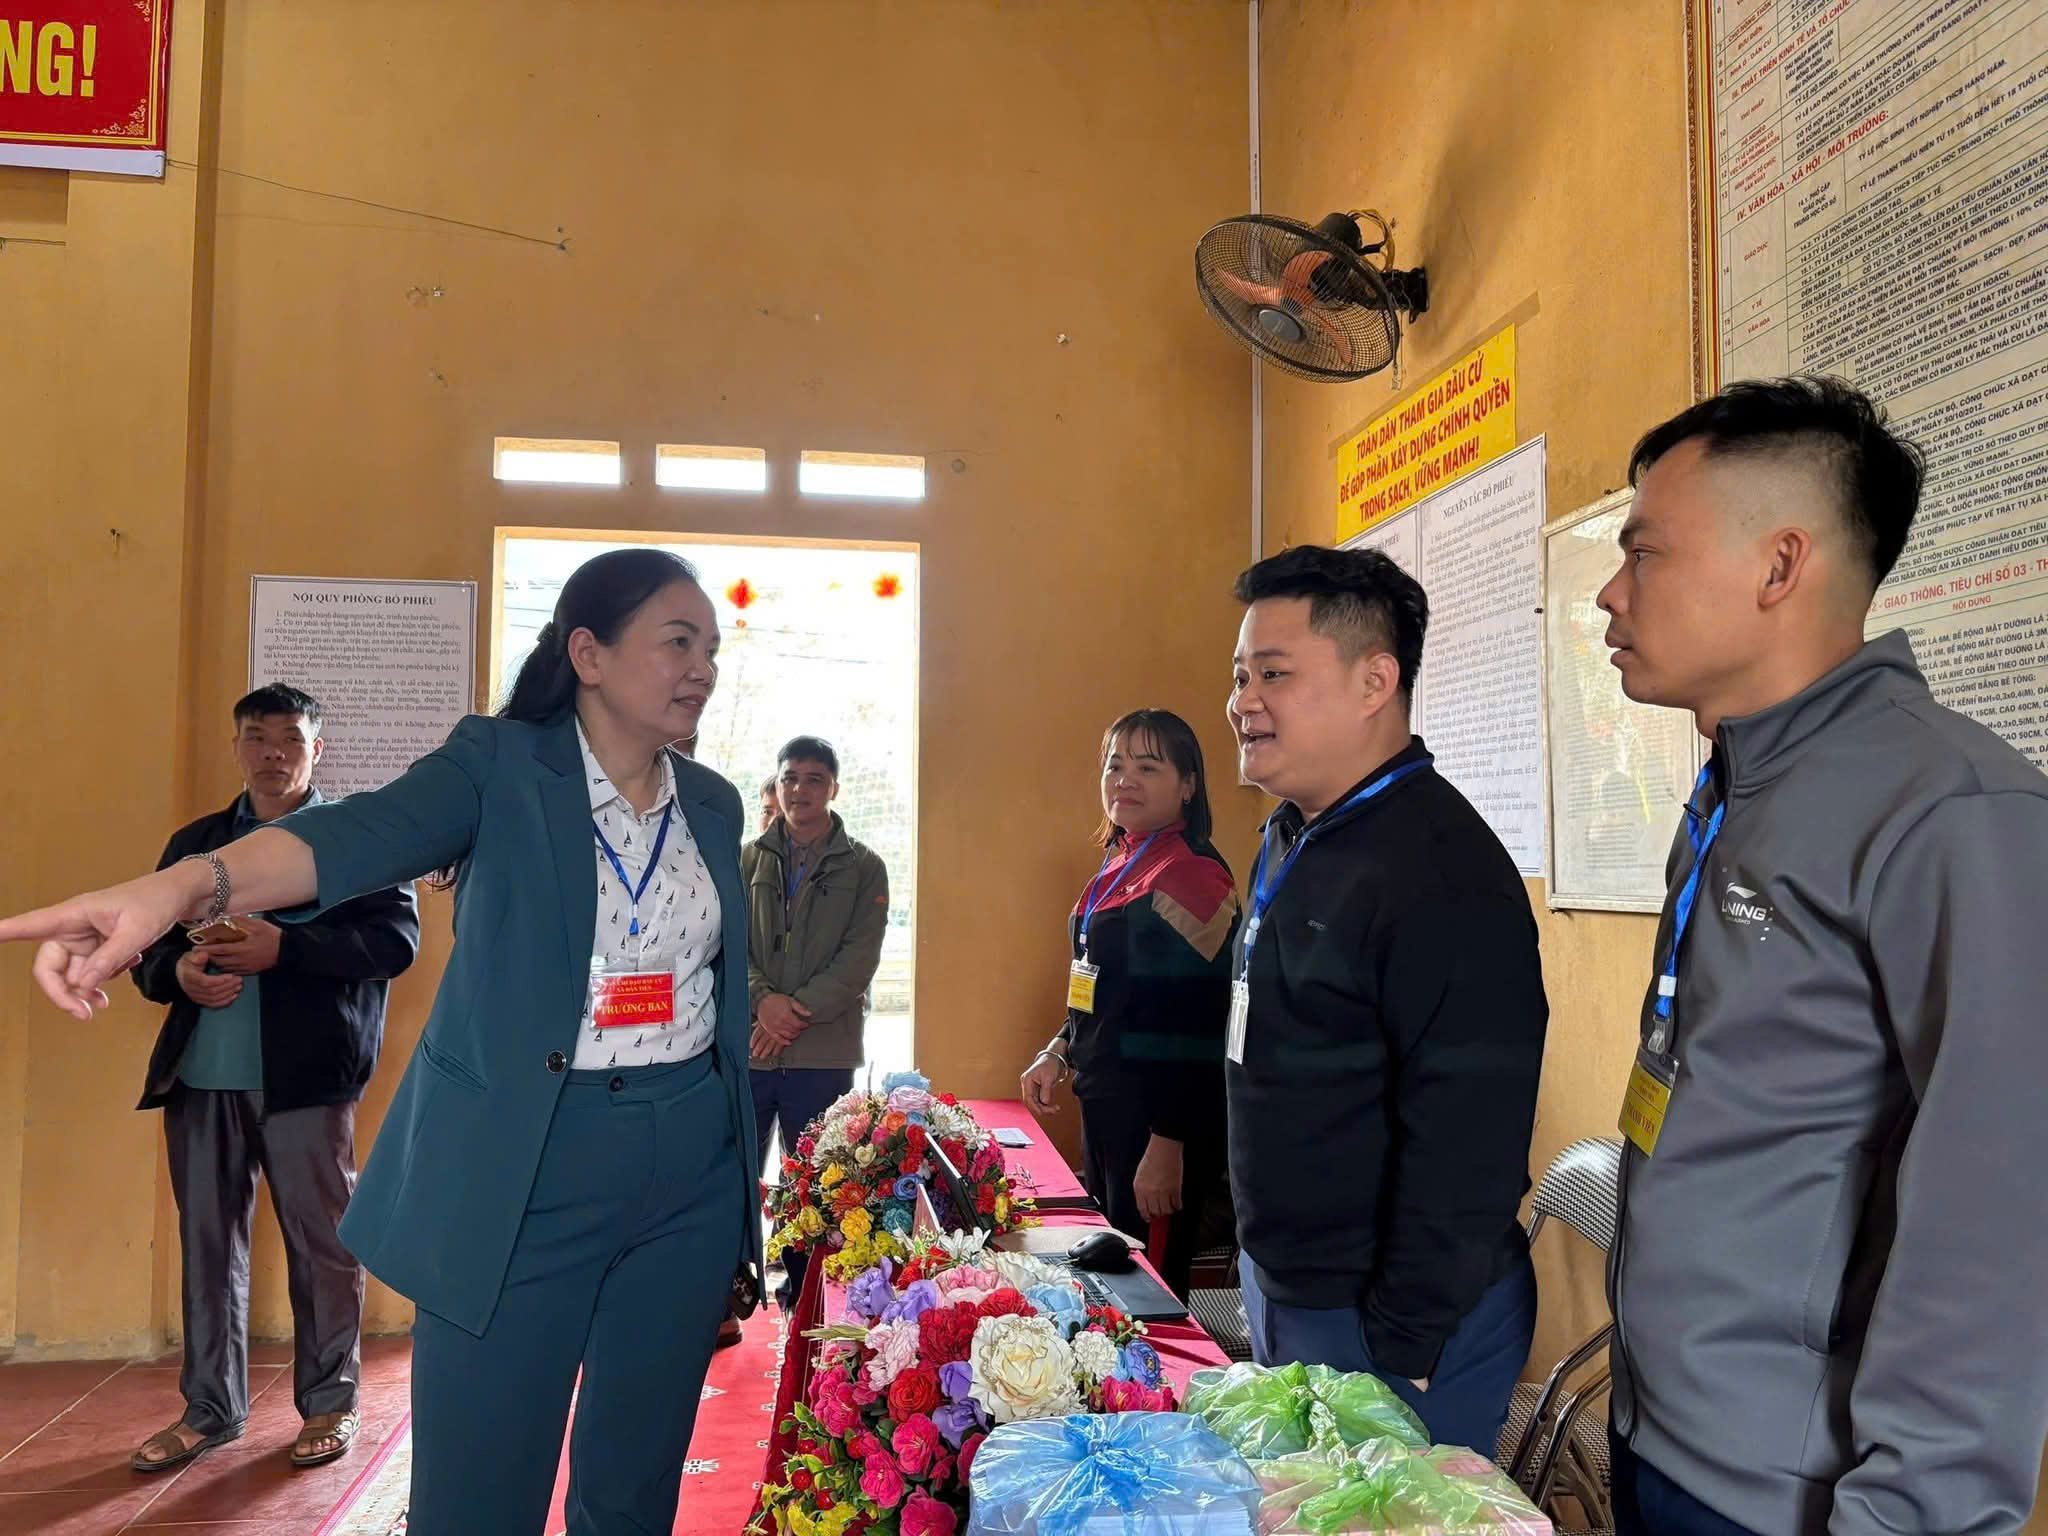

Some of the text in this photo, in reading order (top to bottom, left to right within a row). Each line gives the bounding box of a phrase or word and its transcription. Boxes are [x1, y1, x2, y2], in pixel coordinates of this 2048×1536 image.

[1779, 42, 1795, 61] KINH
[1357, 431, 1377, 462] TOÀN
[1379, 417, 1396, 450] DÂN
[1399, 398, 1425, 435] THAM
[1427, 386, 1443, 415] GIA
[1446, 369, 1465, 402] BẦU
[1366, 455, 1388, 487] PHẦN
[1391, 442, 1408, 473] XÂY
[1410, 426, 1436, 463] DỰNG
[1438, 403, 1469, 442] CHÍNH
[1473, 377, 1510, 423] QUYỀN
[1997, 433, 2017, 445] THEO
[2019, 425, 2037, 437] QUY
[1360, 490, 1386, 523] TRONG
[1414, 457, 1440, 491] VỮNG
[1443, 435, 1480, 477] MẠNH!
[1884, 594, 1908, 610] GIAO
[2013, 564, 2027, 577] 03
[316, 593, 338, 604] QUY
[1968, 595, 1992, 608] DUNG
[1997, 660, 2017, 670] THEO
[1999, 704, 2016, 714] CAO
